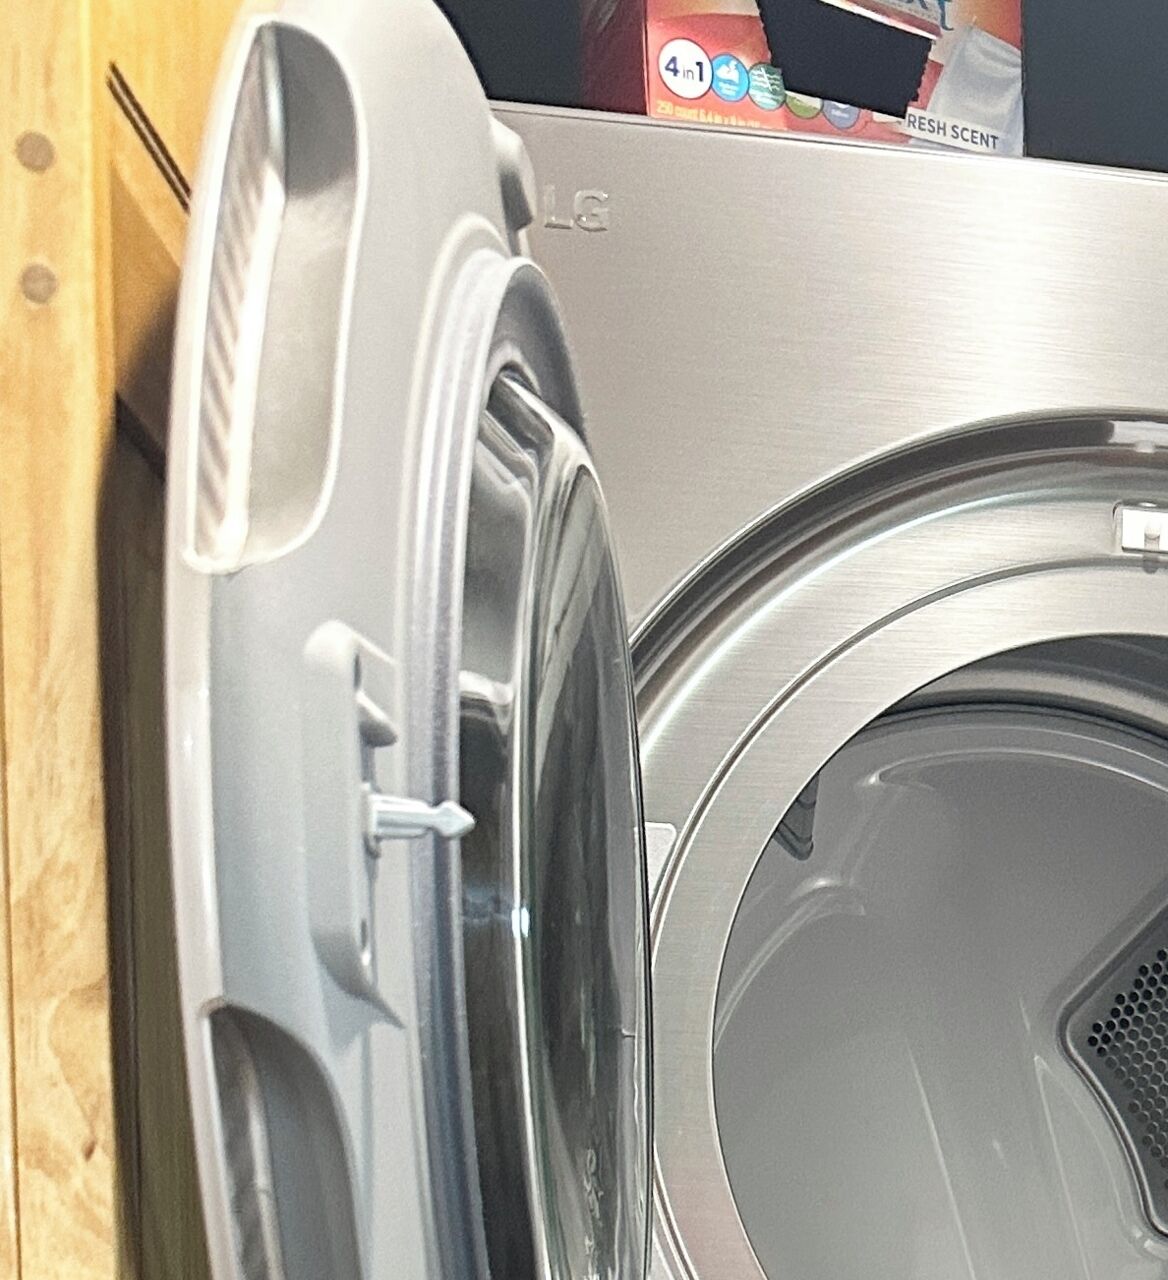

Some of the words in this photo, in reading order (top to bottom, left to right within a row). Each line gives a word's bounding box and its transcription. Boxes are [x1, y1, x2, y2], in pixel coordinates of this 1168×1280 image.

[665, 56, 679, 77] 4
[683, 67, 694, 80] in
[696, 61, 704, 82] 1
[907, 113, 947, 137] RESH
[951, 124, 999, 149] SCENT
[544, 186, 609, 232] LG
